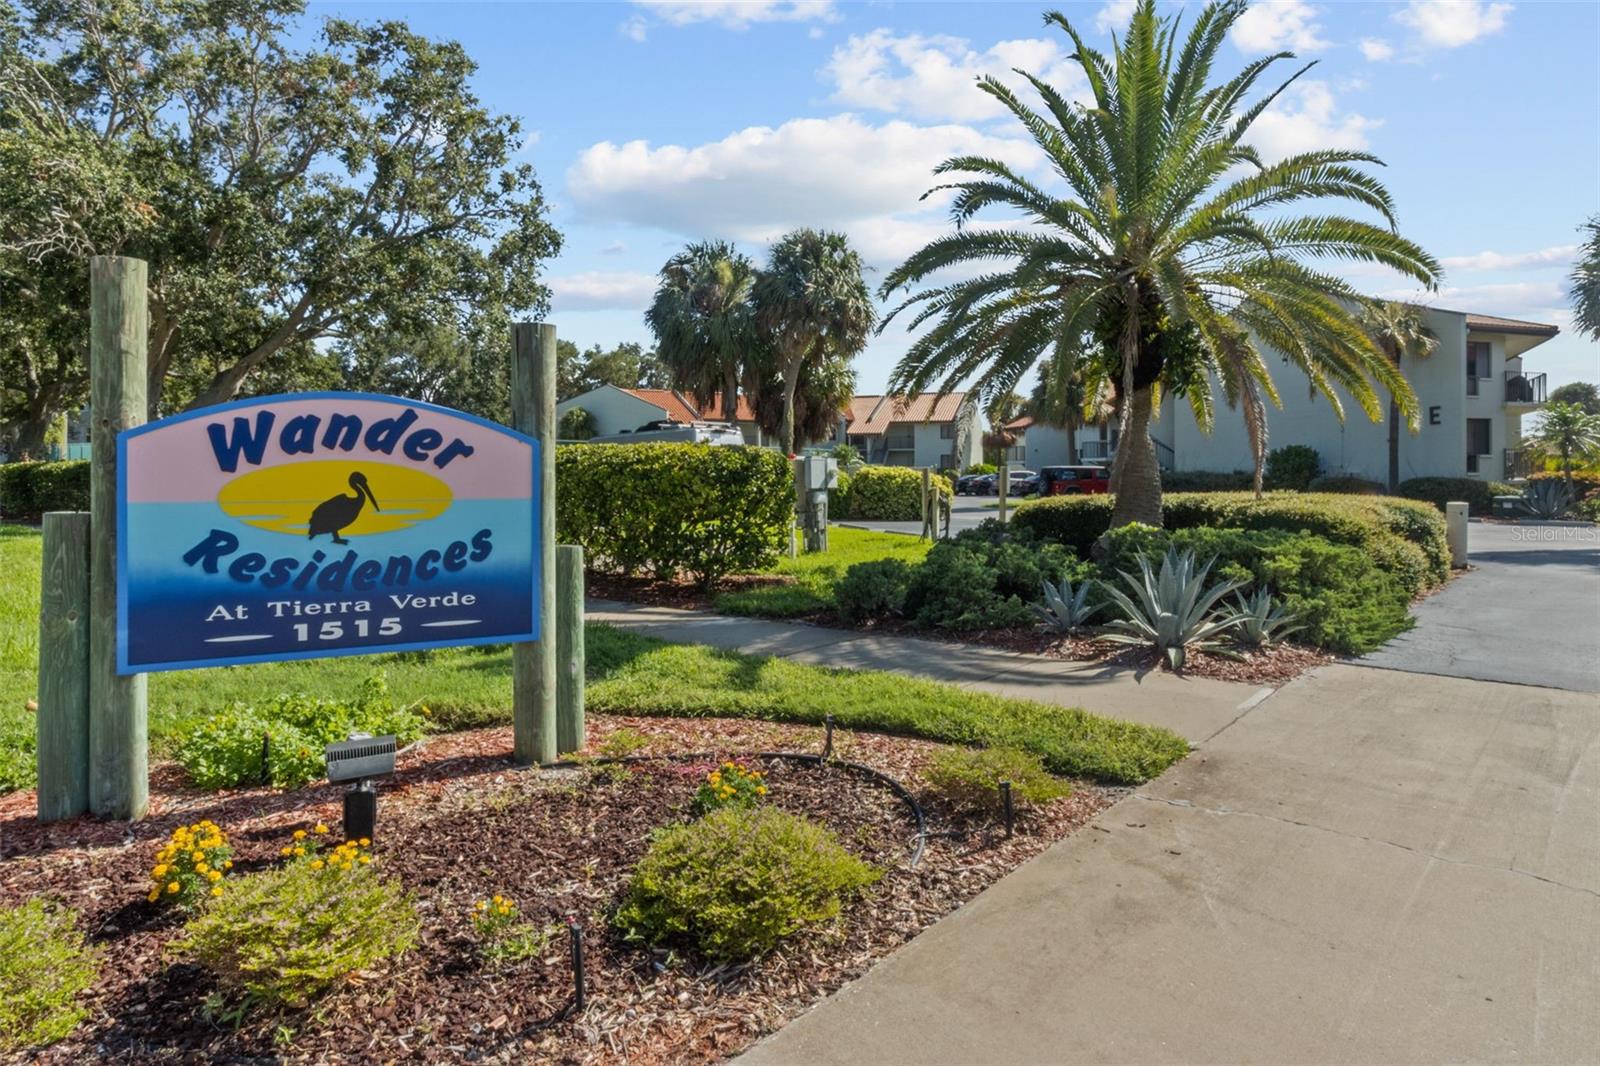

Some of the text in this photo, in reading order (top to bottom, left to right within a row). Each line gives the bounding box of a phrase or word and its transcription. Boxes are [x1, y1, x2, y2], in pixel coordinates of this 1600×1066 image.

[1429, 405, 1442, 425] E
[207, 408, 475, 473] Wander
[182, 528, 494, 592] Residences
[205, 591, 477, 622] At Tierra Verde
[293, 617, 403, 642] 1515
